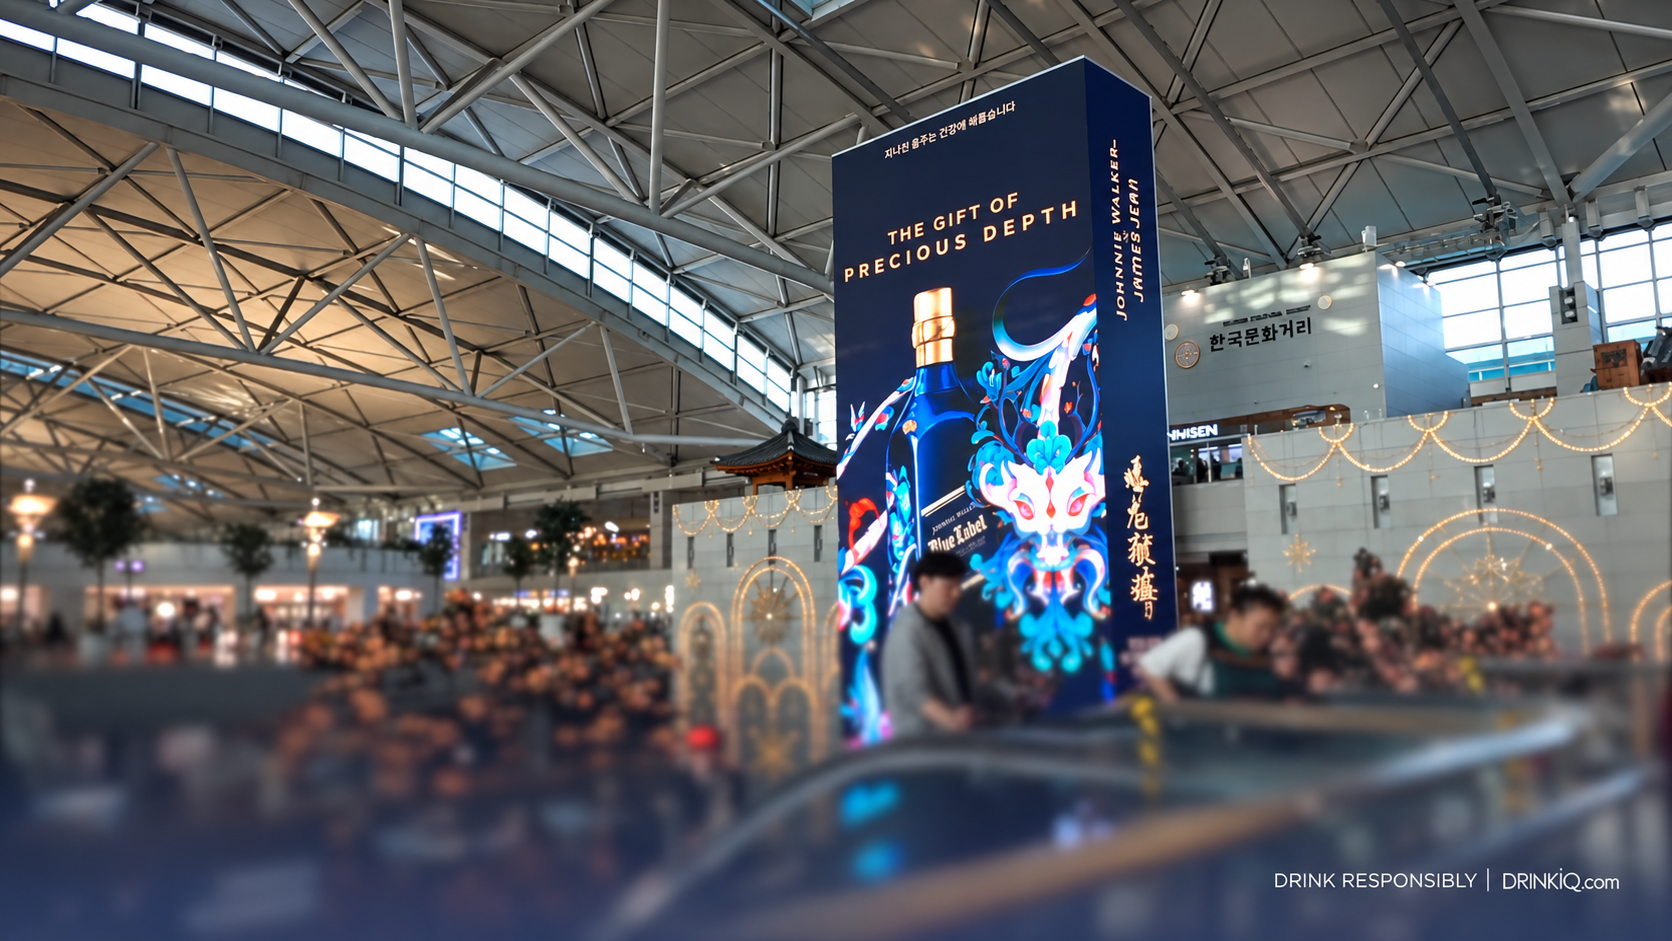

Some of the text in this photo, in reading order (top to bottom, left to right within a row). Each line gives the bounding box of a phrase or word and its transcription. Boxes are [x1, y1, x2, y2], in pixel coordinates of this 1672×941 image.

[884, 141, 910, 159] 지나친
[911, 132, 937, 150] 음주는
[938, 119, 967, 139] 건강에
[844, 200, 1078, 283] PRECIOUS DEPTH
[887, 191, 1018, 246] THE GIFT OF
[1113, 231, 1128, 321] JOHNNIE
[1130, 231, 1144, 303] JAMES
[1209, 316, 1312, 352] 한국문화거리
[927, 534, 956, 552] Blue
[953, 514, 988, 546] Label
